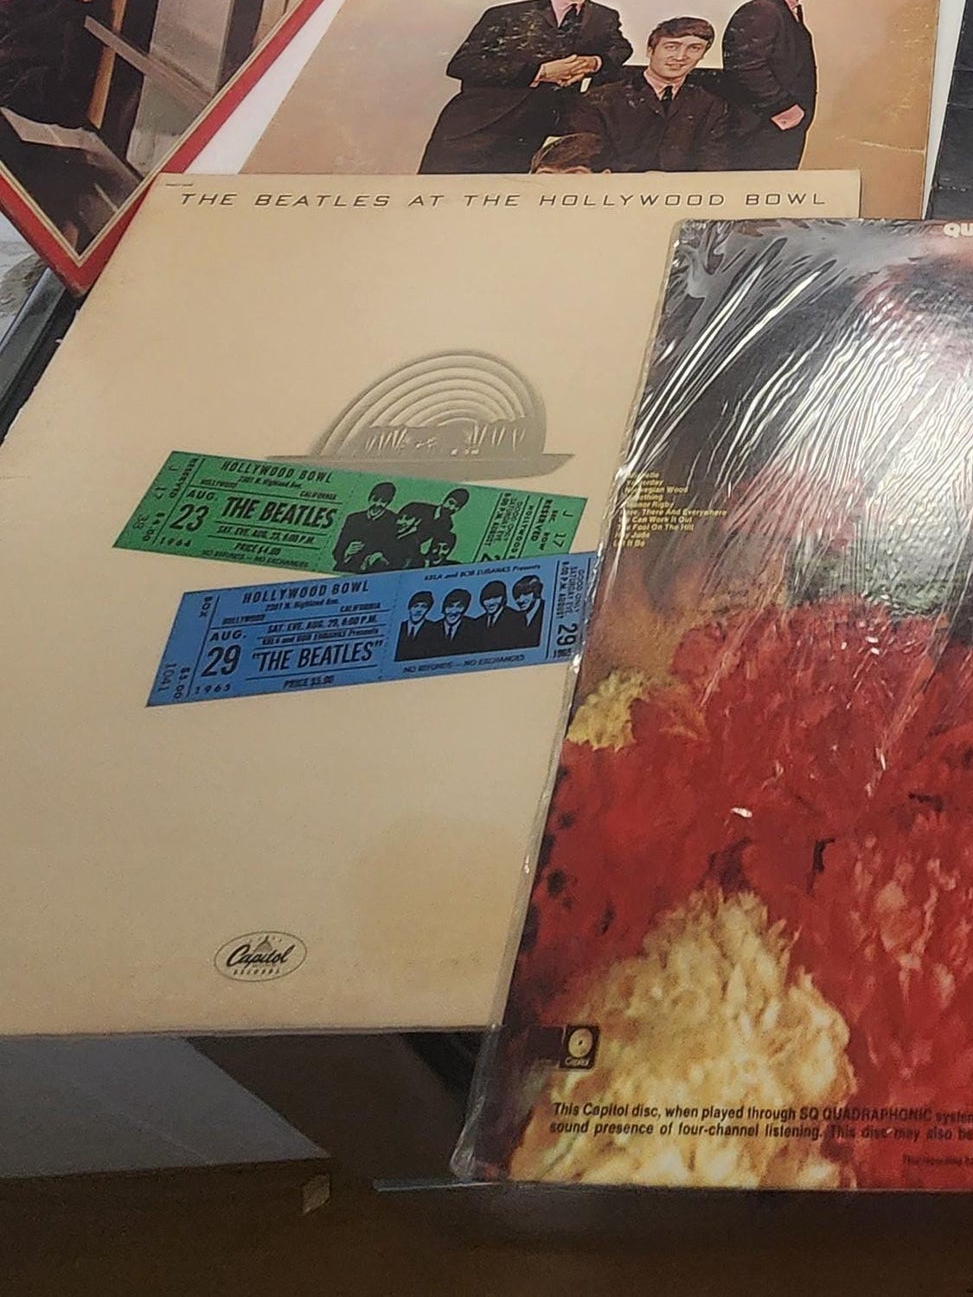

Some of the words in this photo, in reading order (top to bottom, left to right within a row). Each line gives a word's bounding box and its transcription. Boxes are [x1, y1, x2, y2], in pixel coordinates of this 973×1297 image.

[180, 193, 238, 206] THE
[254, 193, 391, 207] BEATLES
[407, 194, 445, 207] AT
[463, 193, 521, 207] THE
[538, 193, 727, 207] HOLLYWOOD
[745, 192, 826, 206] BOWL
[220, 461, 295, 479] HOLLYWOOD
[298, 470, 333, 483] BOWL
[186, 489, 218, 501] AUG.
[169, 504, 210, 532] 23
[221, 496, 260, 519] THE
[259, 501, 338, 530] BEATLES
[530, 499, 554, 542] RESERVED
[553, 533, 567, 549] 17
[242, 584, 327, 603] HOLLYWOOD
[331, 579, 369, 594] BOWL
[199, 596, 213, 618] BOX
[210, 630, 246, 641] AUG.
[556, 623, 578, 647] 29
[201, 644, 241, 677] 29
[158, 663, 177, 692] 1041
[195, 683, 231, 694] 1965
[226, 940, 296, 969] Capitol
[553, 1102, 579, 1116] This
[583, 1103, 628, 1117] Capitol
[632, 1104, 662, 1120] disc,
[665, 1105, 698, 1117] when
[701, 1105, 744, 1121] played
[747, 1105, 796, 1122] through
[799, 1107, 819, 1121] SQ
[822, 1107, 932, 1122] QUADRAPHONIC
[550, 1121, 589, 1133] sound
[594, 1121, 653, 1137] presence
[659, 1122, 673, 1135] of
[678, 1122, 759, 1137] four-channel
[764, 1123, 822, 1140] listening.
[828, 1124, 856, 1137] This
[894, 1128, 920, 1142] may
[926, 1126, 953, 1139] also
[957, 1127, 973, 1140] be
